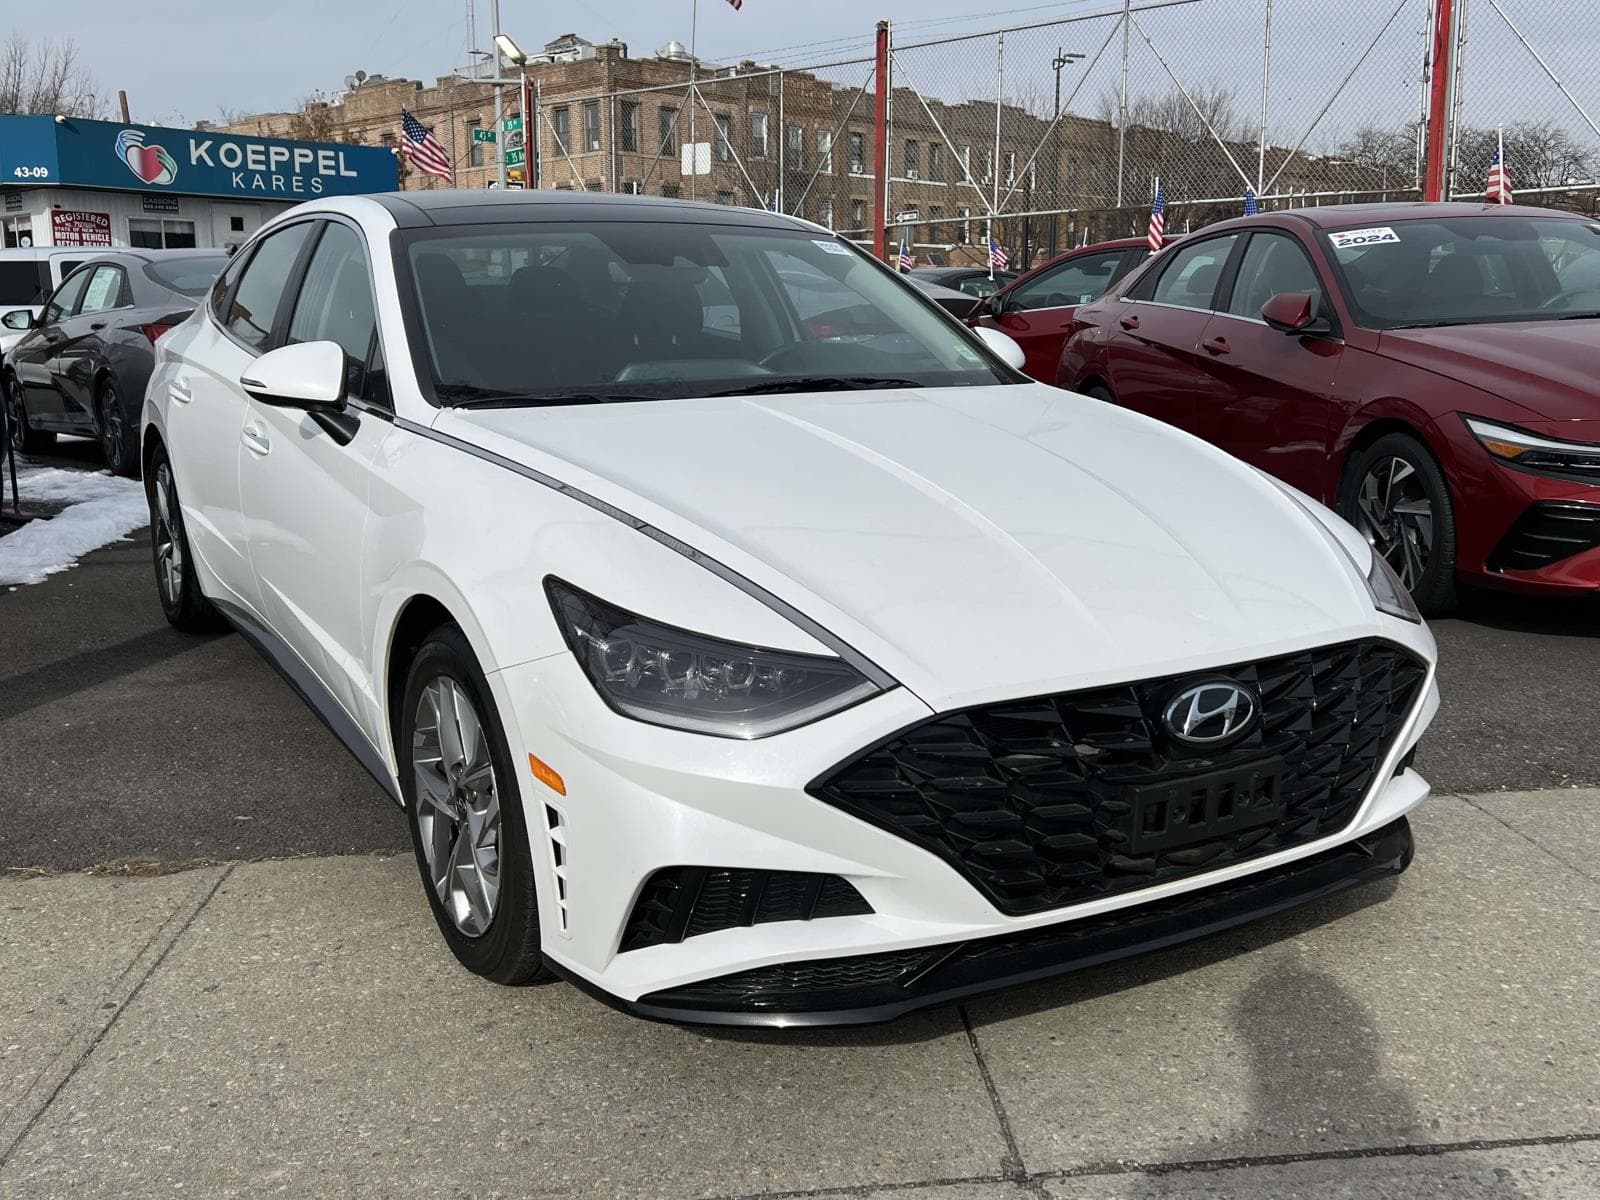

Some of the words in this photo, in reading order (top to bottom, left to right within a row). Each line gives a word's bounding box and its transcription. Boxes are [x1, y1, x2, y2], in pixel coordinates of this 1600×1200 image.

[189, 138, 358, 178] KOEPPEL
[14, 166, 48, 178] 43-09
[231, 172, 324, 194] KARES
[54, 212, 109, 227] REGISTERED
[54, 231, 80, 241] MOTOR
[82, 232, 111, 242] VEHICLE
[1337, 233, 1397, 247] 2024
